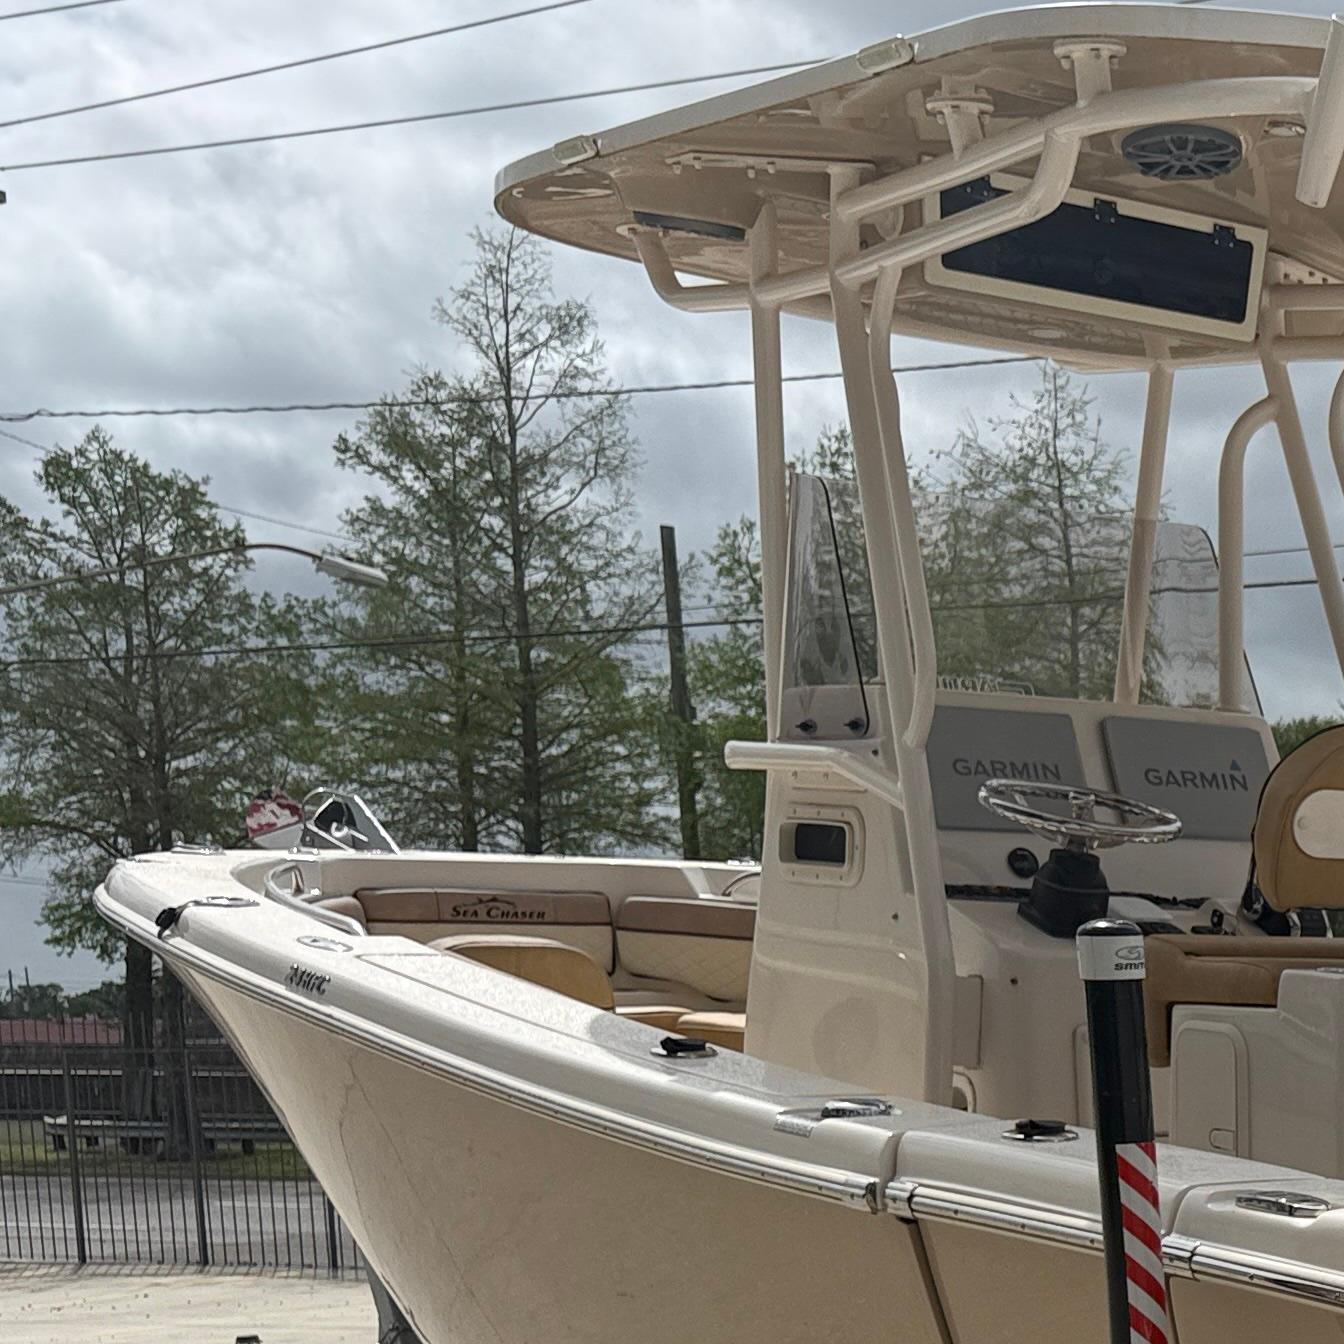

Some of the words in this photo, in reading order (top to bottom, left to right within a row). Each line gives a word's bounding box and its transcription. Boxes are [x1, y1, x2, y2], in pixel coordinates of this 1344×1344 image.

[952, 758, 1061, 781] GARMIN
[1144, 768, 1249, 792] GARMIN
[450, 904, 479, 919] SEA
